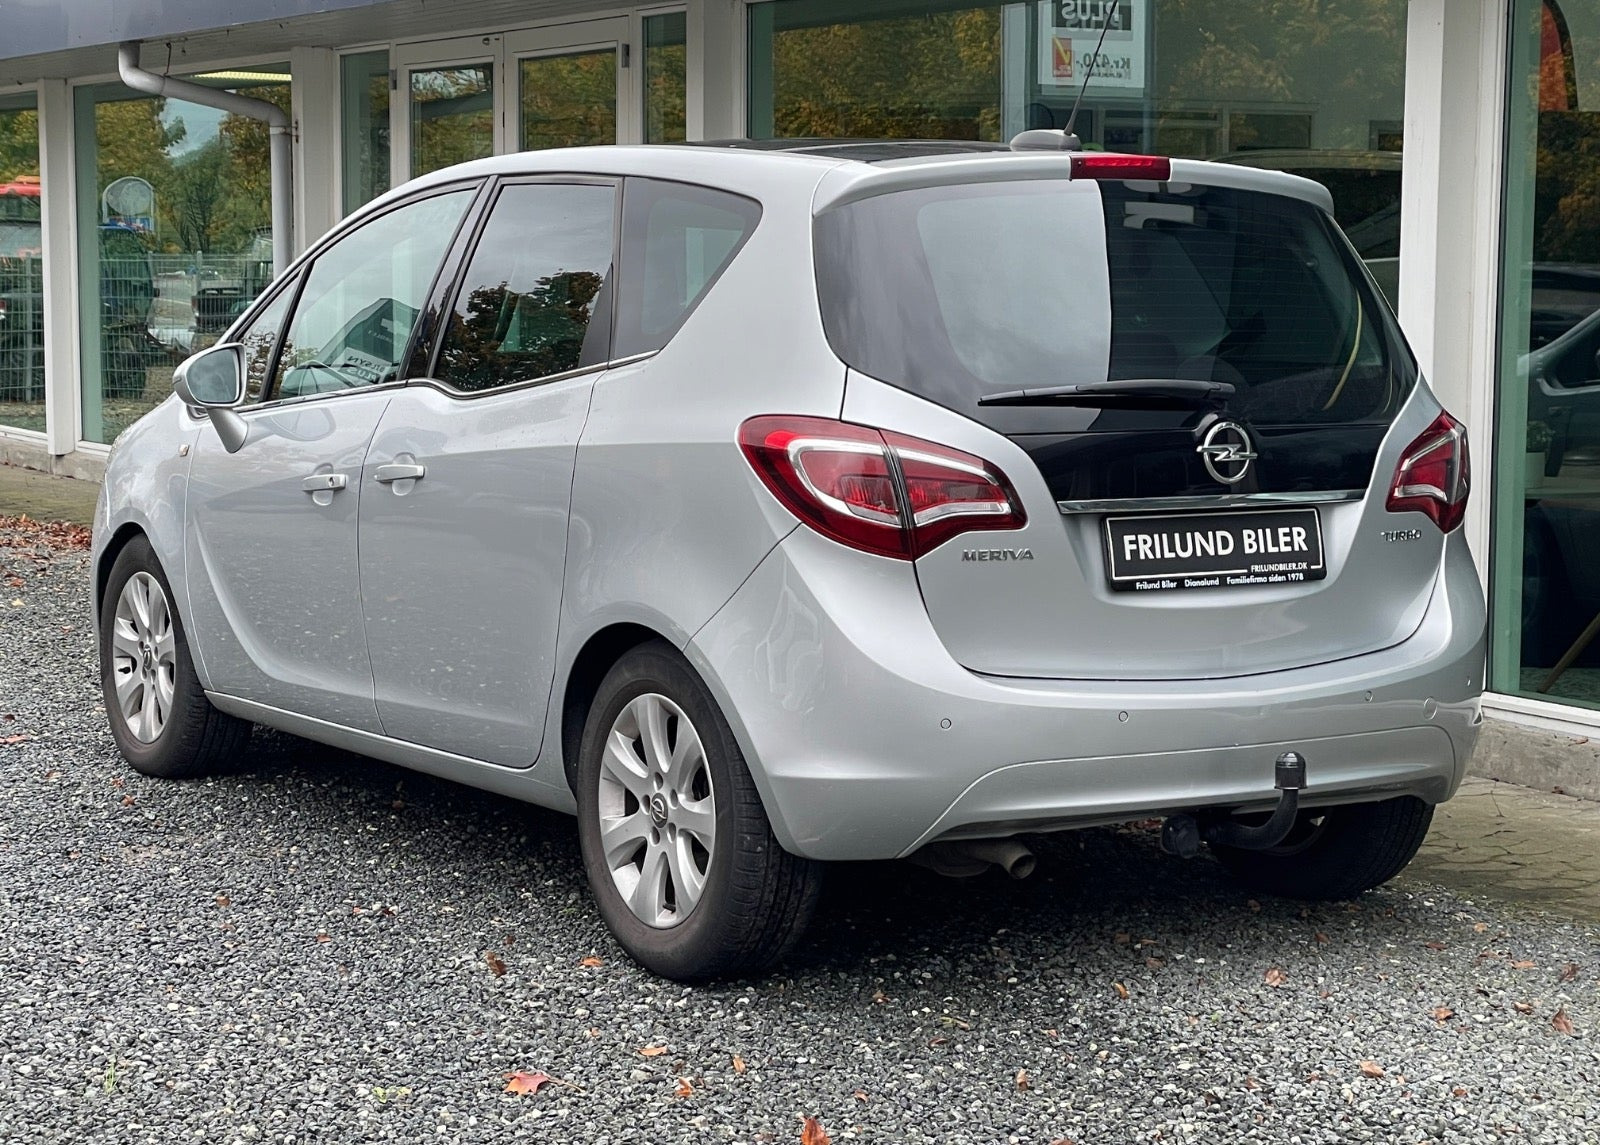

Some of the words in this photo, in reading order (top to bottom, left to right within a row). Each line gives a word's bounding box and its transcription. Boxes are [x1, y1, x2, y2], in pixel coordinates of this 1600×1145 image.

[1381, 529, 1422, 541] TURBO
[1123, 530, 1235, 561] FRILUND
[1242, 526, 1308, 554] BILER
[961, 547, 1034, 562] MERIVA
[1250, 562, 1308, 573] FRILUNDBILER.DK
[1136, 580, 1160, 590] Frilund
[1161, 579, 1177, 589] Biler
[1184, 577, 1220, 587] Dianalund
[1226, 575, 1268, 585] Familiefirma
[1268, 573, 1286, 583] siden
[1287, 572, 1304, 581] 1978
